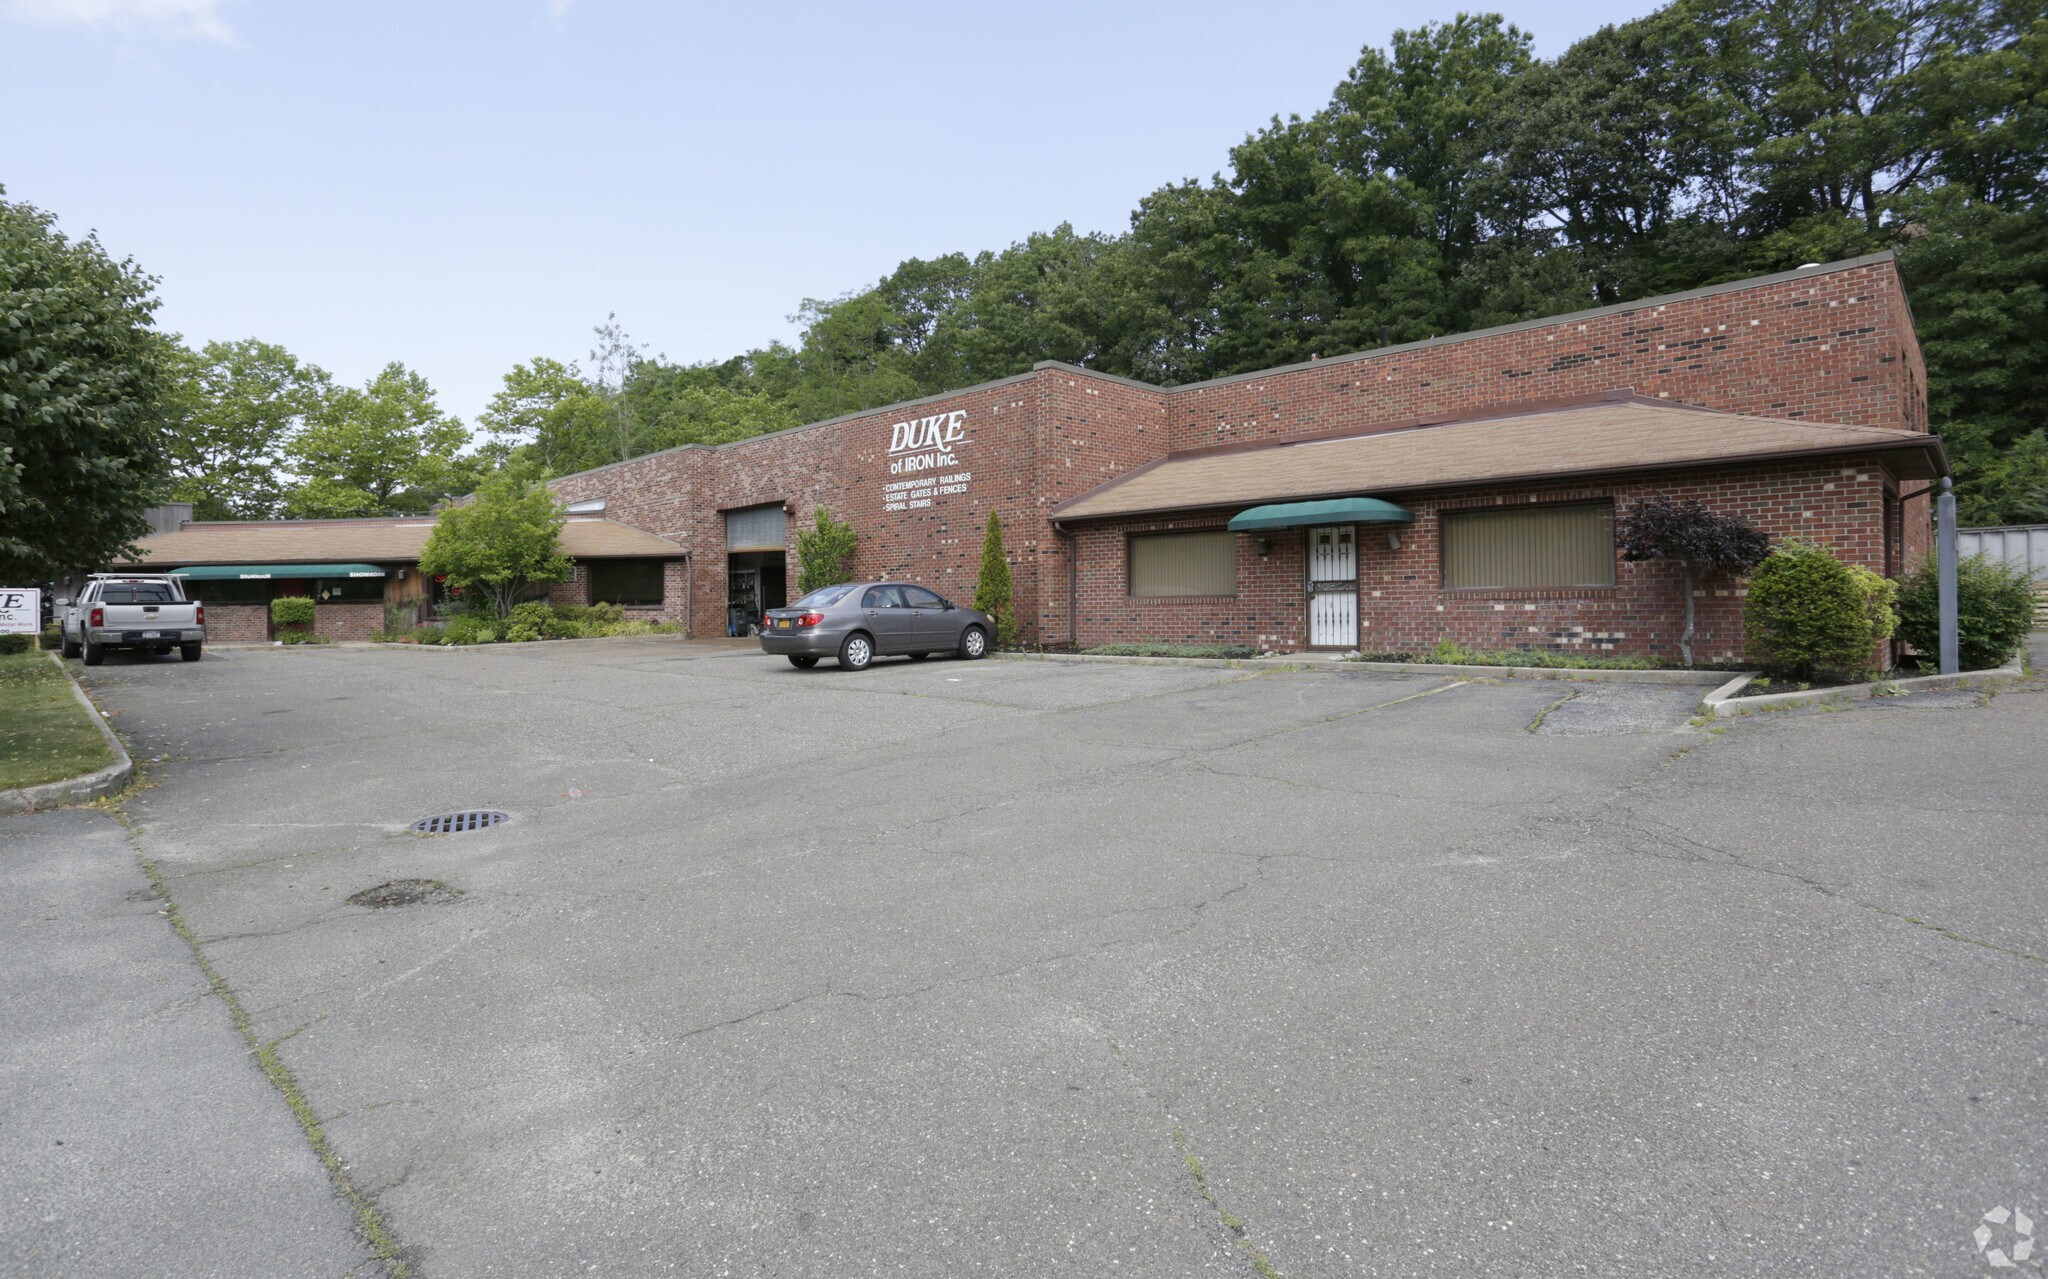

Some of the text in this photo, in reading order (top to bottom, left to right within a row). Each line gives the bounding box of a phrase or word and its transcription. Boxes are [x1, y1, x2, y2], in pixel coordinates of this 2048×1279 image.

[888, 409, 967, 452] DUKE
[890, 452, 959, 474] of IRON Inc.
[885, 472, 971, 493] CONTEMPORARY RAILINGS
[885, 483, 967, 502] ESTATE GATES & FENCES
[885, 498, 932, 512] SPIRAL STAIRS
[0, 594, 25, 609] E
